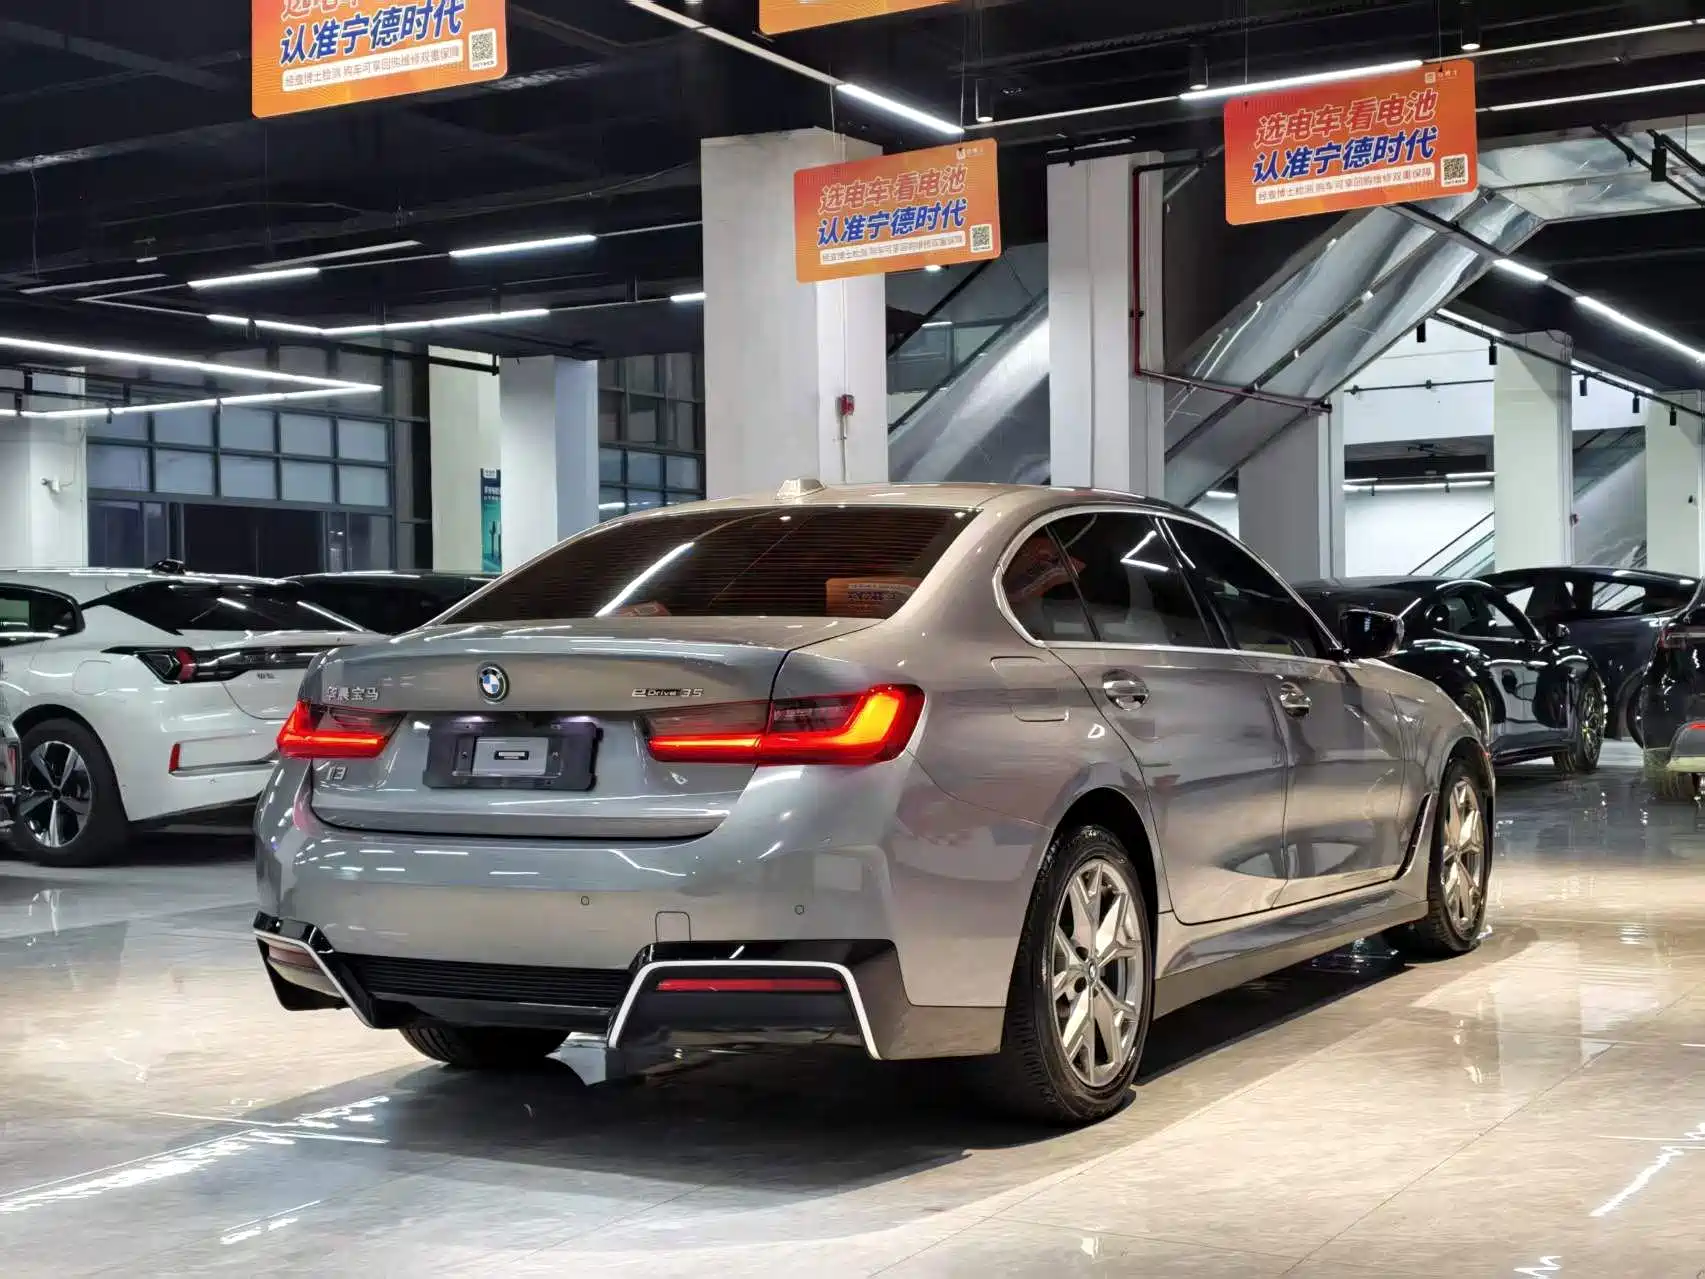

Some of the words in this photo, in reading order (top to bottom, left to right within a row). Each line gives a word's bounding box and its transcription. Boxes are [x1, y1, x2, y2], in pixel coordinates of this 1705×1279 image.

[279, 0, 465, 67] 认准宁德时代
[1254, 103, 1344, 149] 选电车
[1344, 88, 1439, 132] 看电池
[1252, 125, 1439, 184] 认准宁德时代
[817, 176, 892, 214] 选电车
[892, 164, 967, 202] 看电池
[817, 197, 967, 248] 认准宁德时代
